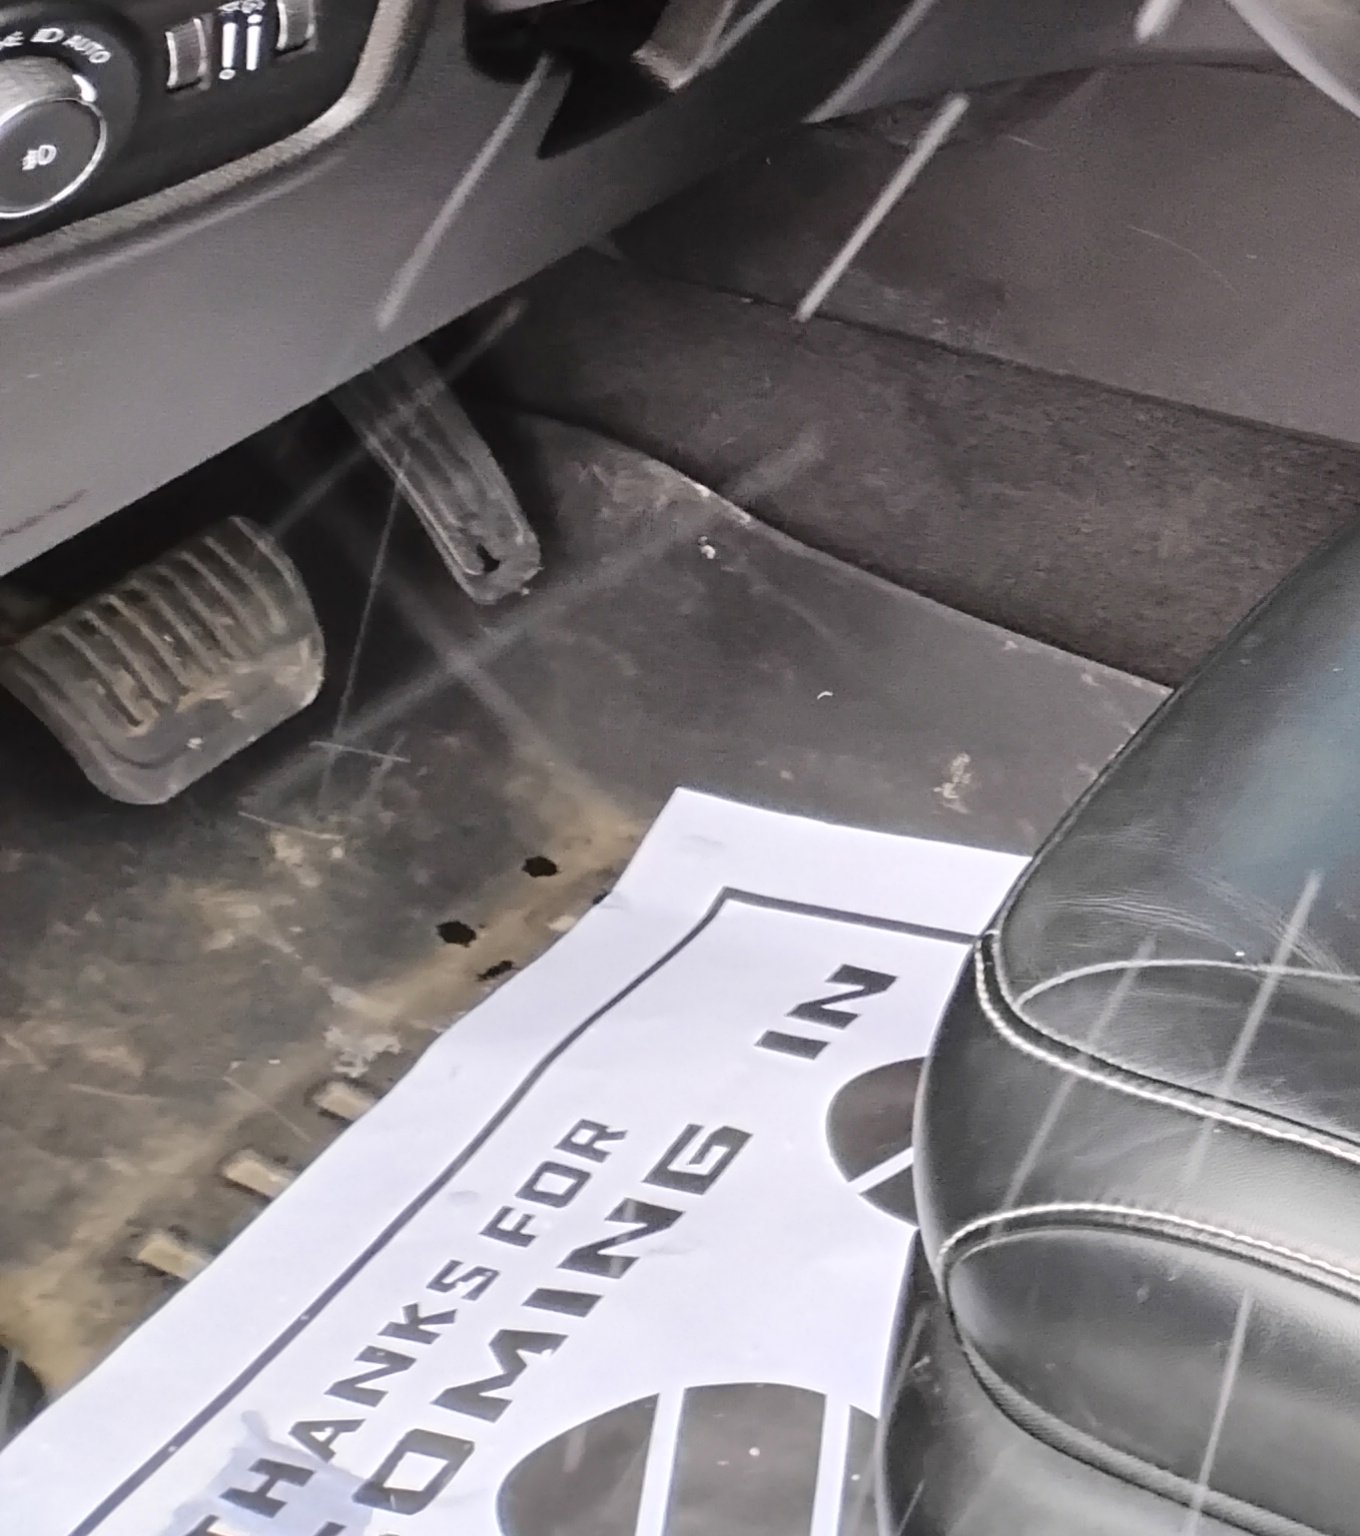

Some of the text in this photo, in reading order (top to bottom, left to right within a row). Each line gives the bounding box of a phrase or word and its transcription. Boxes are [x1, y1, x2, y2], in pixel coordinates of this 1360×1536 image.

[62, 34, 111, 64] AUTO
[479, 1118, 628, 1248] FOR
[305, 963, 898, 1536] OMING IN
